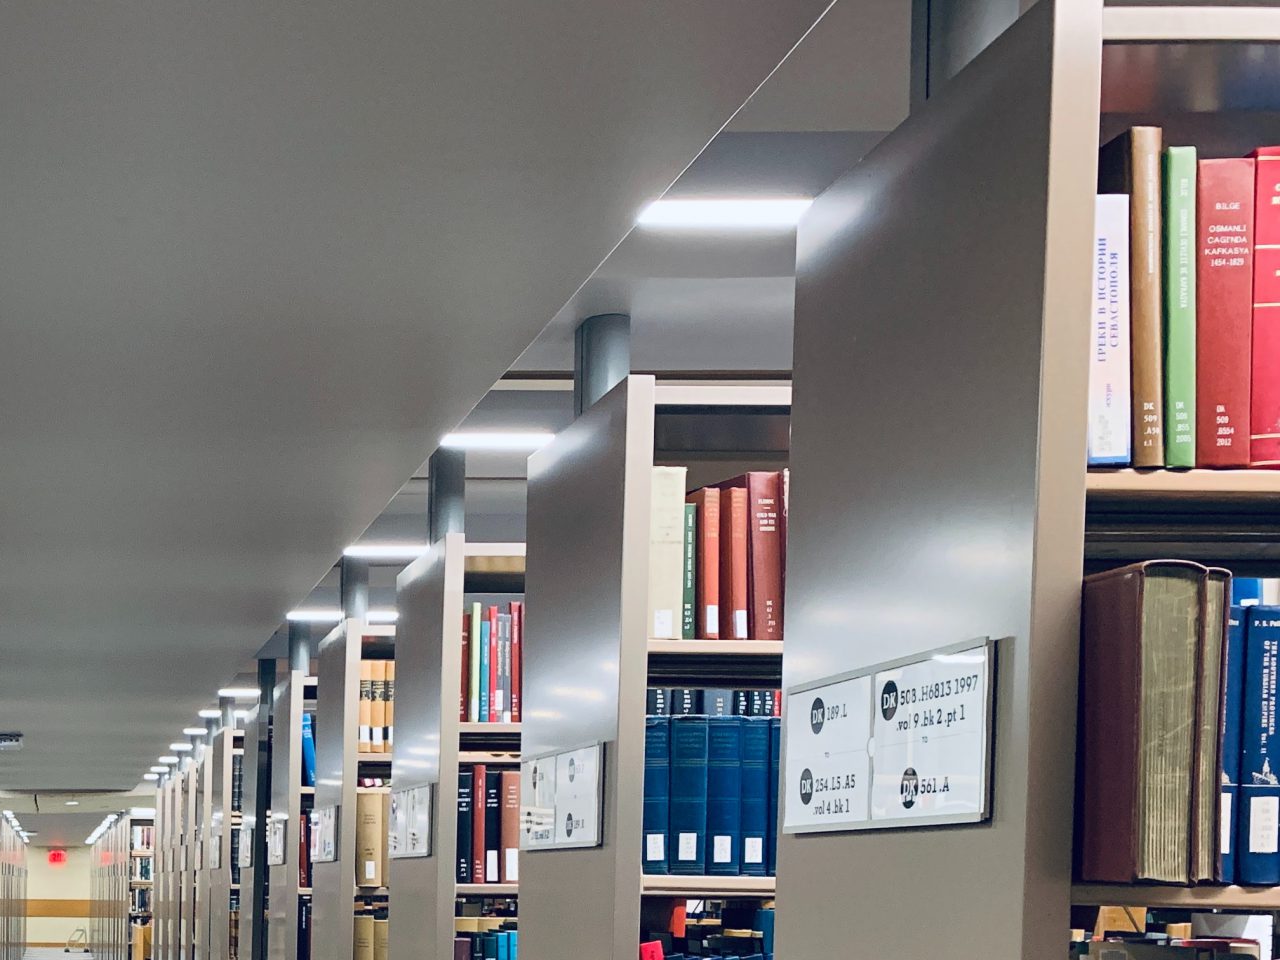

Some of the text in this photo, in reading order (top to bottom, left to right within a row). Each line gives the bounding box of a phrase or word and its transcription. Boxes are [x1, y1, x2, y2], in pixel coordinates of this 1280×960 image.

[1215, 201, 1241, 211] BILGE
[1204, 247, 1250, 256] KAFKASYA
[1263, 640, 1270, 650] OF
[1269, 657, 1277, 695] SOUTHERN
[882, 692, 896, 709] DK
[954, 674, 978, 695] 1997
[812, 708, 824, 724] DK
[913, 712, 920, 728] 9
[936, 708, 943, 725] 2
[959, 704, 966, 720] 1
[801, 779, 812, 794] DK
[902, 779, 918, 796] DK
[845, 798, 850, 813] 1
